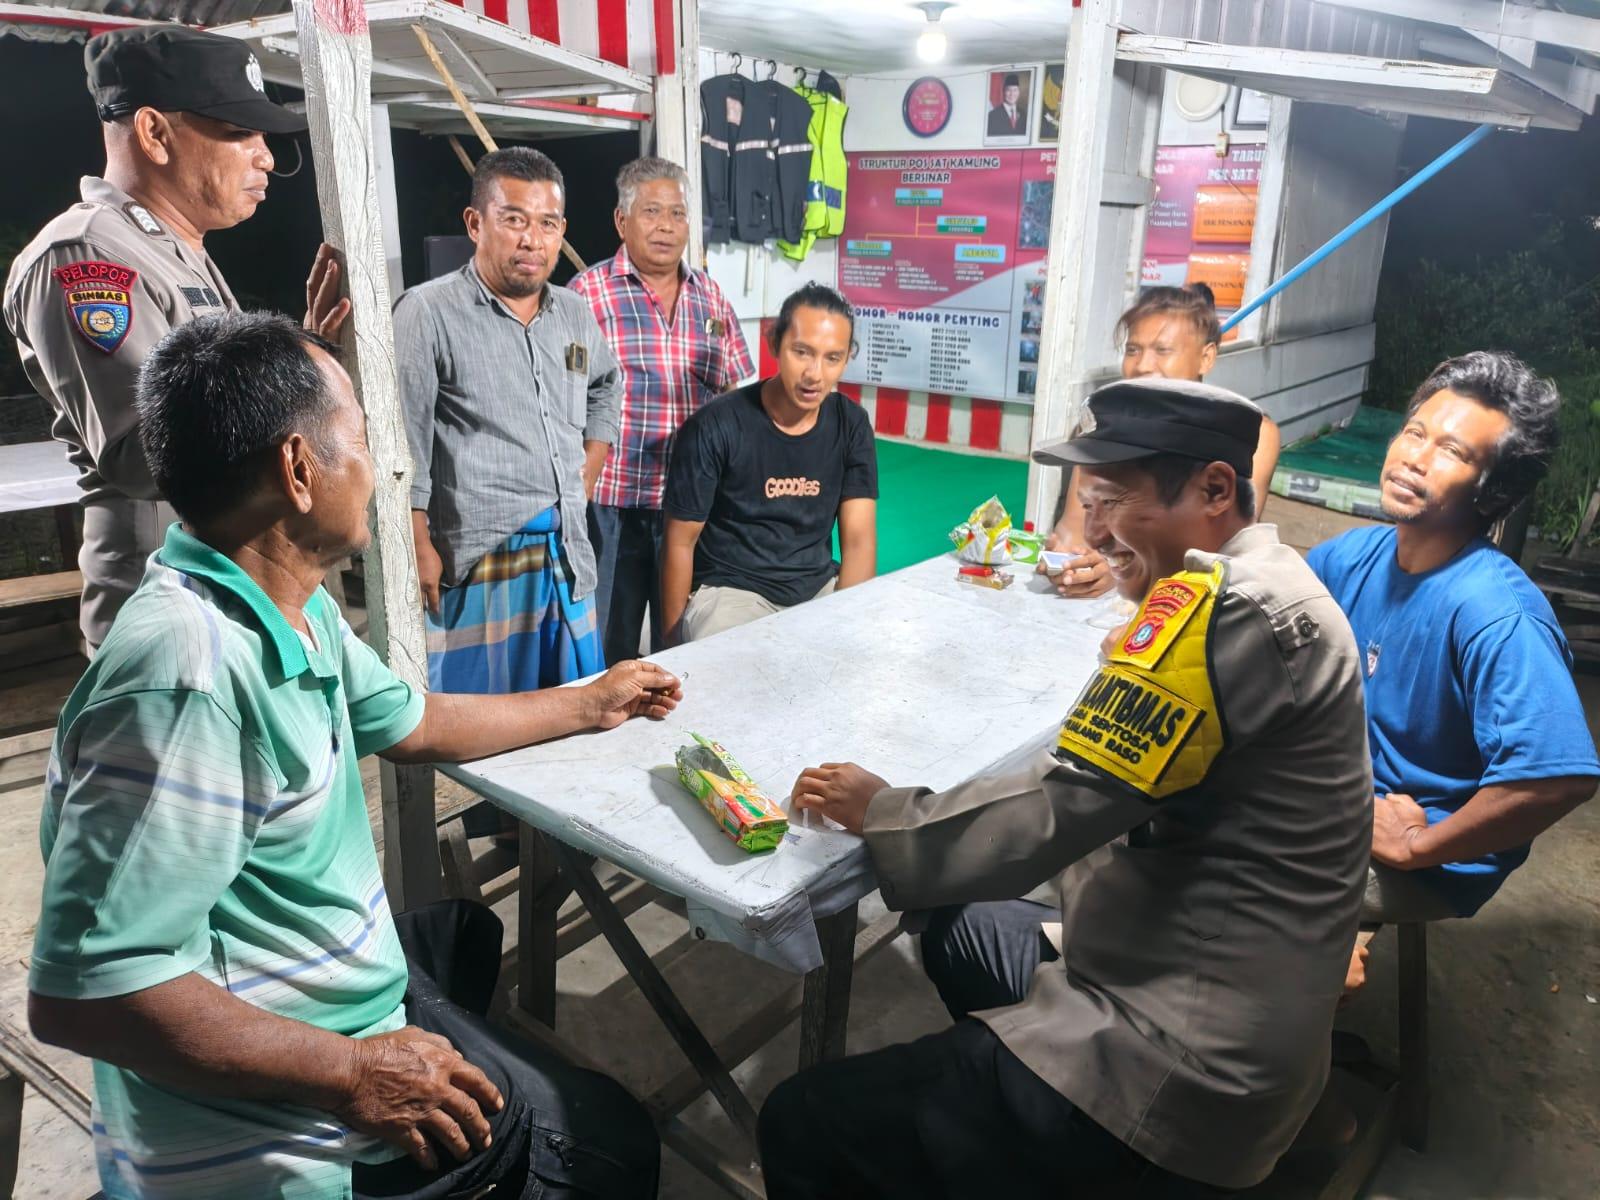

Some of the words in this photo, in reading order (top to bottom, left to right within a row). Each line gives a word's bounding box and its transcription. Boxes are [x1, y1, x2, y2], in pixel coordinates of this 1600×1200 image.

[859, 157, 906, 169] STRUKTUR
[908, 157, 928, 169] POS
[929, 157, 949, 169] SAT
[950, 156, 999, 169] KAMLING
[901, 172, 951, 184] BERSINAR
[60, 264, 129, 285] PELOPOR
[71, 291, 124, 302] BINMAS
[854, 307, 886, 318] OMOR
[898, 310, 940, 323] NOMOR
[944, 313, 1000, 328] PENTING
[1089, 714, 1151, 754] SENTOSA
